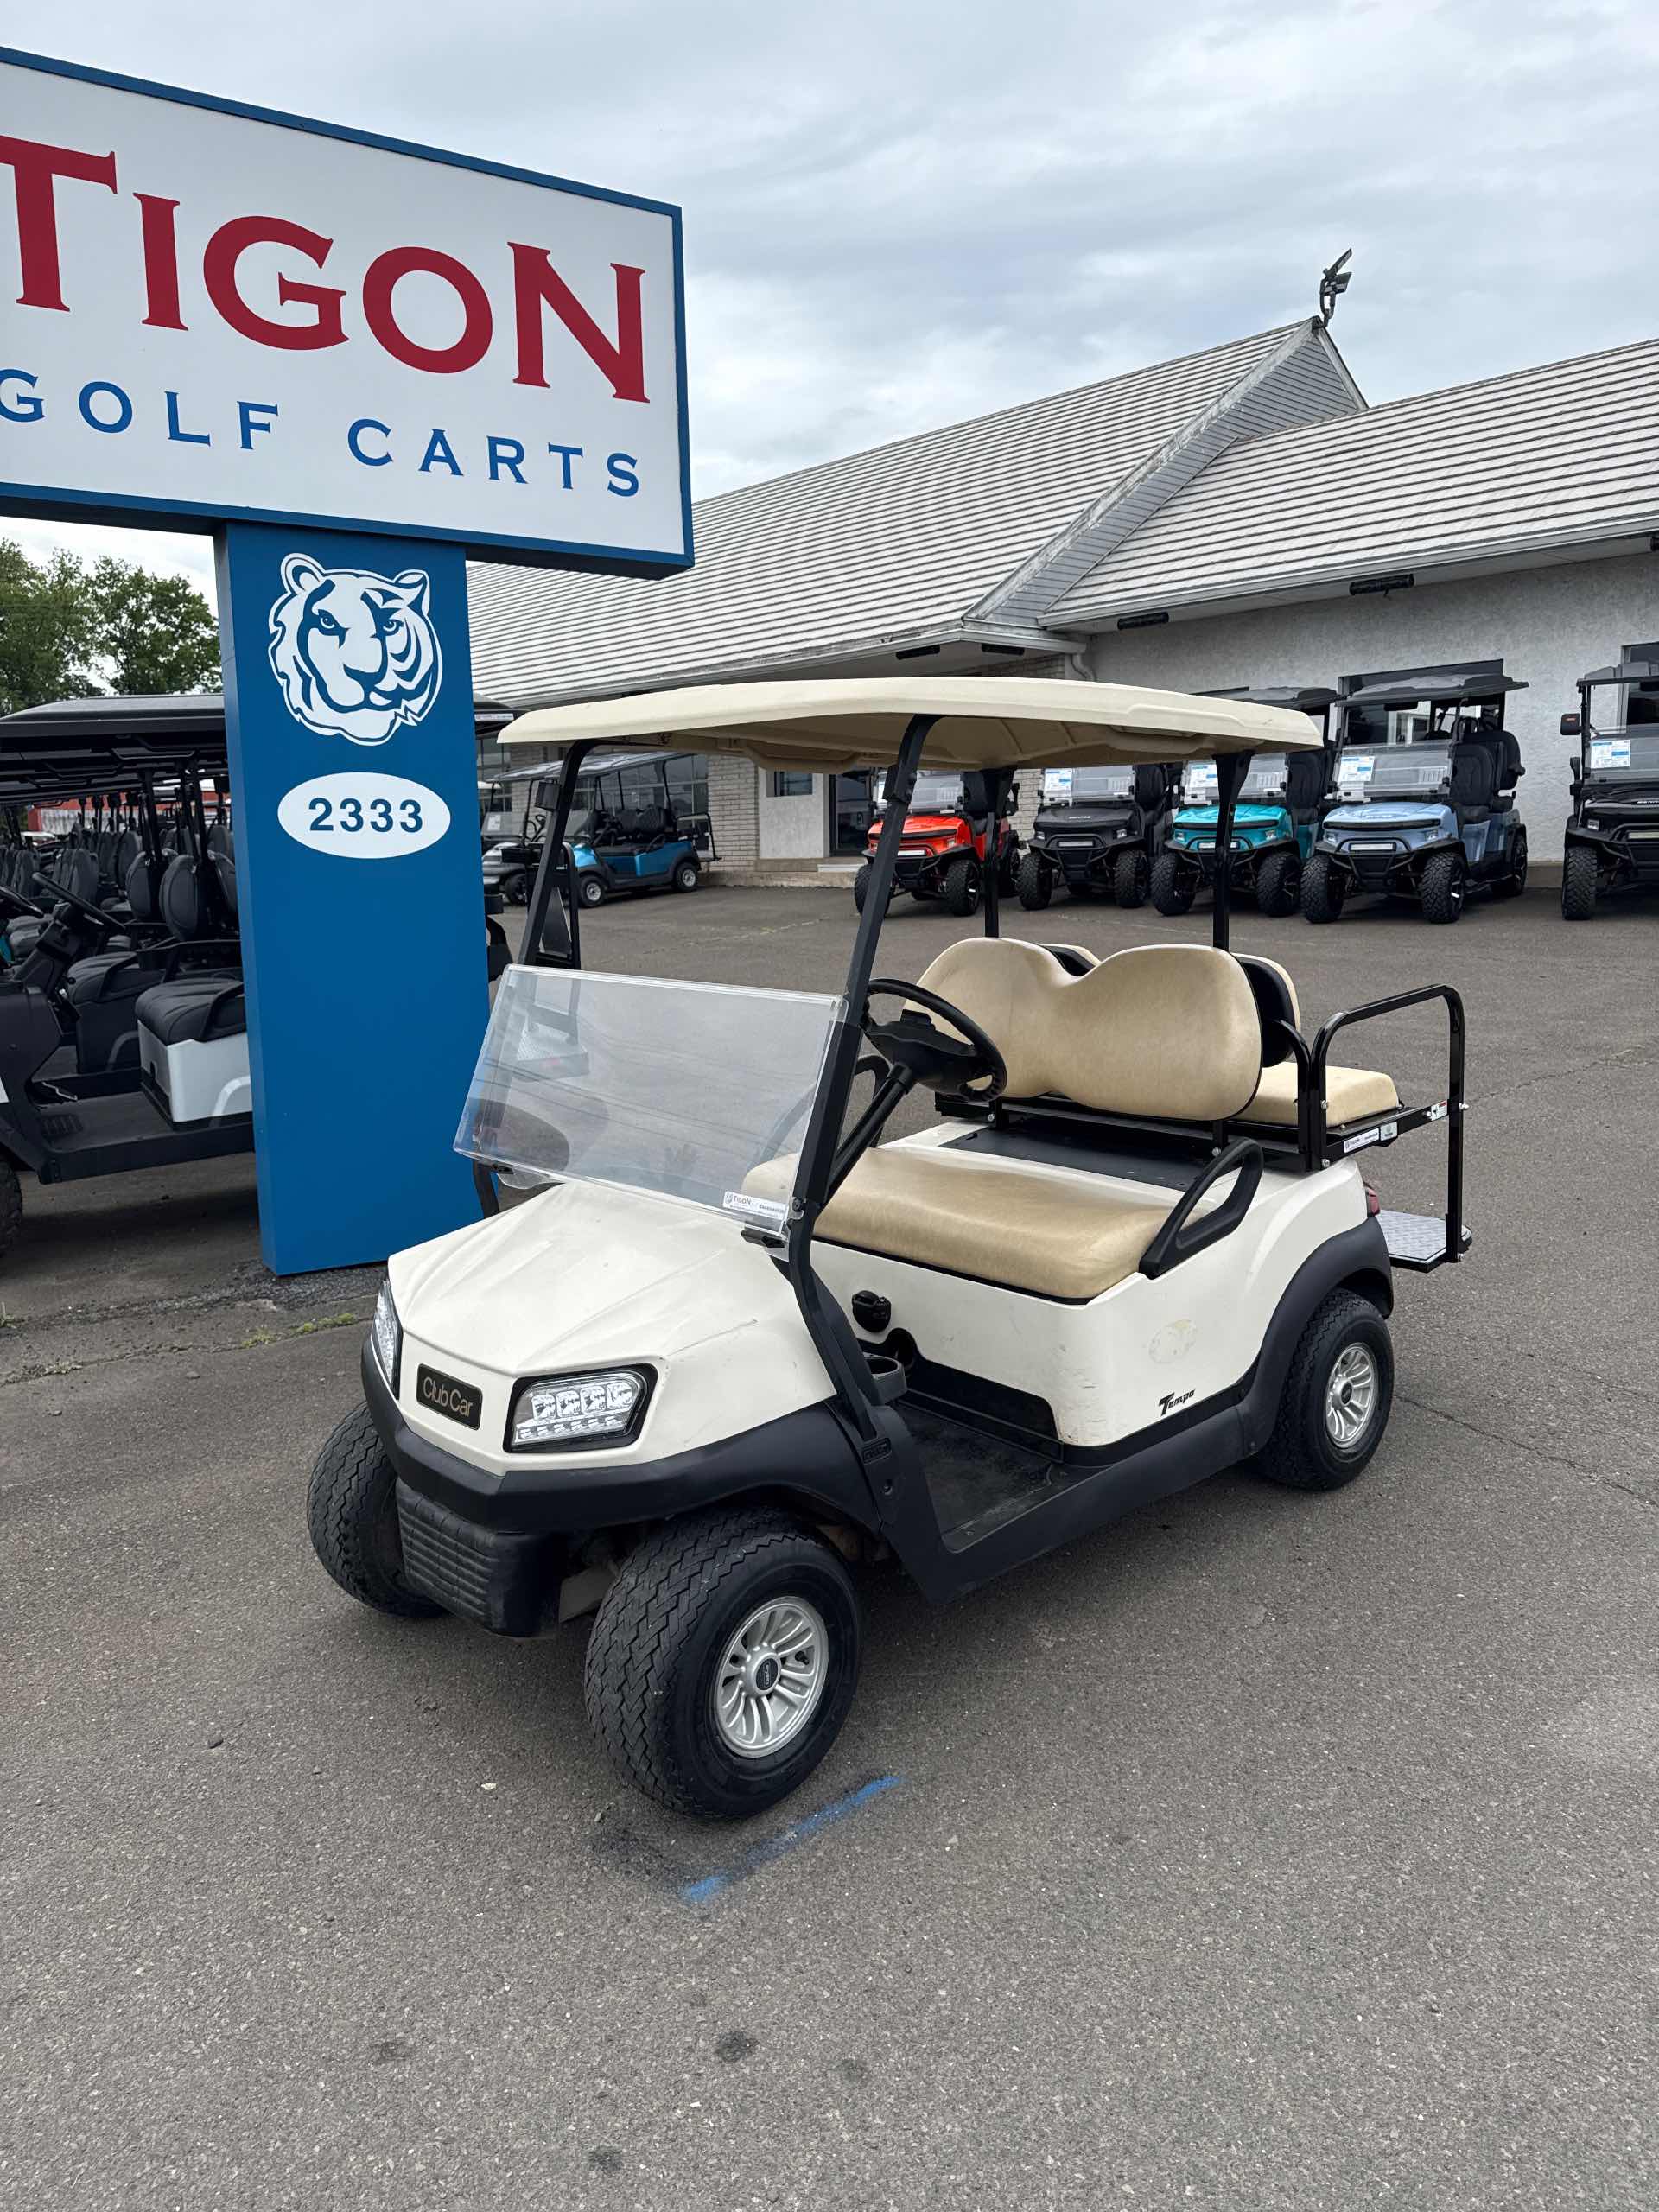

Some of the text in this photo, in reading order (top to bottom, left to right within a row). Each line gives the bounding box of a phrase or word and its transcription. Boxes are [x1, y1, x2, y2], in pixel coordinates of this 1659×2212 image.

[0, 137, 650, 403] TIGON
[0, 368, 640, 498] GOLF CARTS
[308, 797, 423, 834] 2333
[423, 1376, 474, 1417] Club Car
[1158, 1388, 1197, 1416] Tempo
